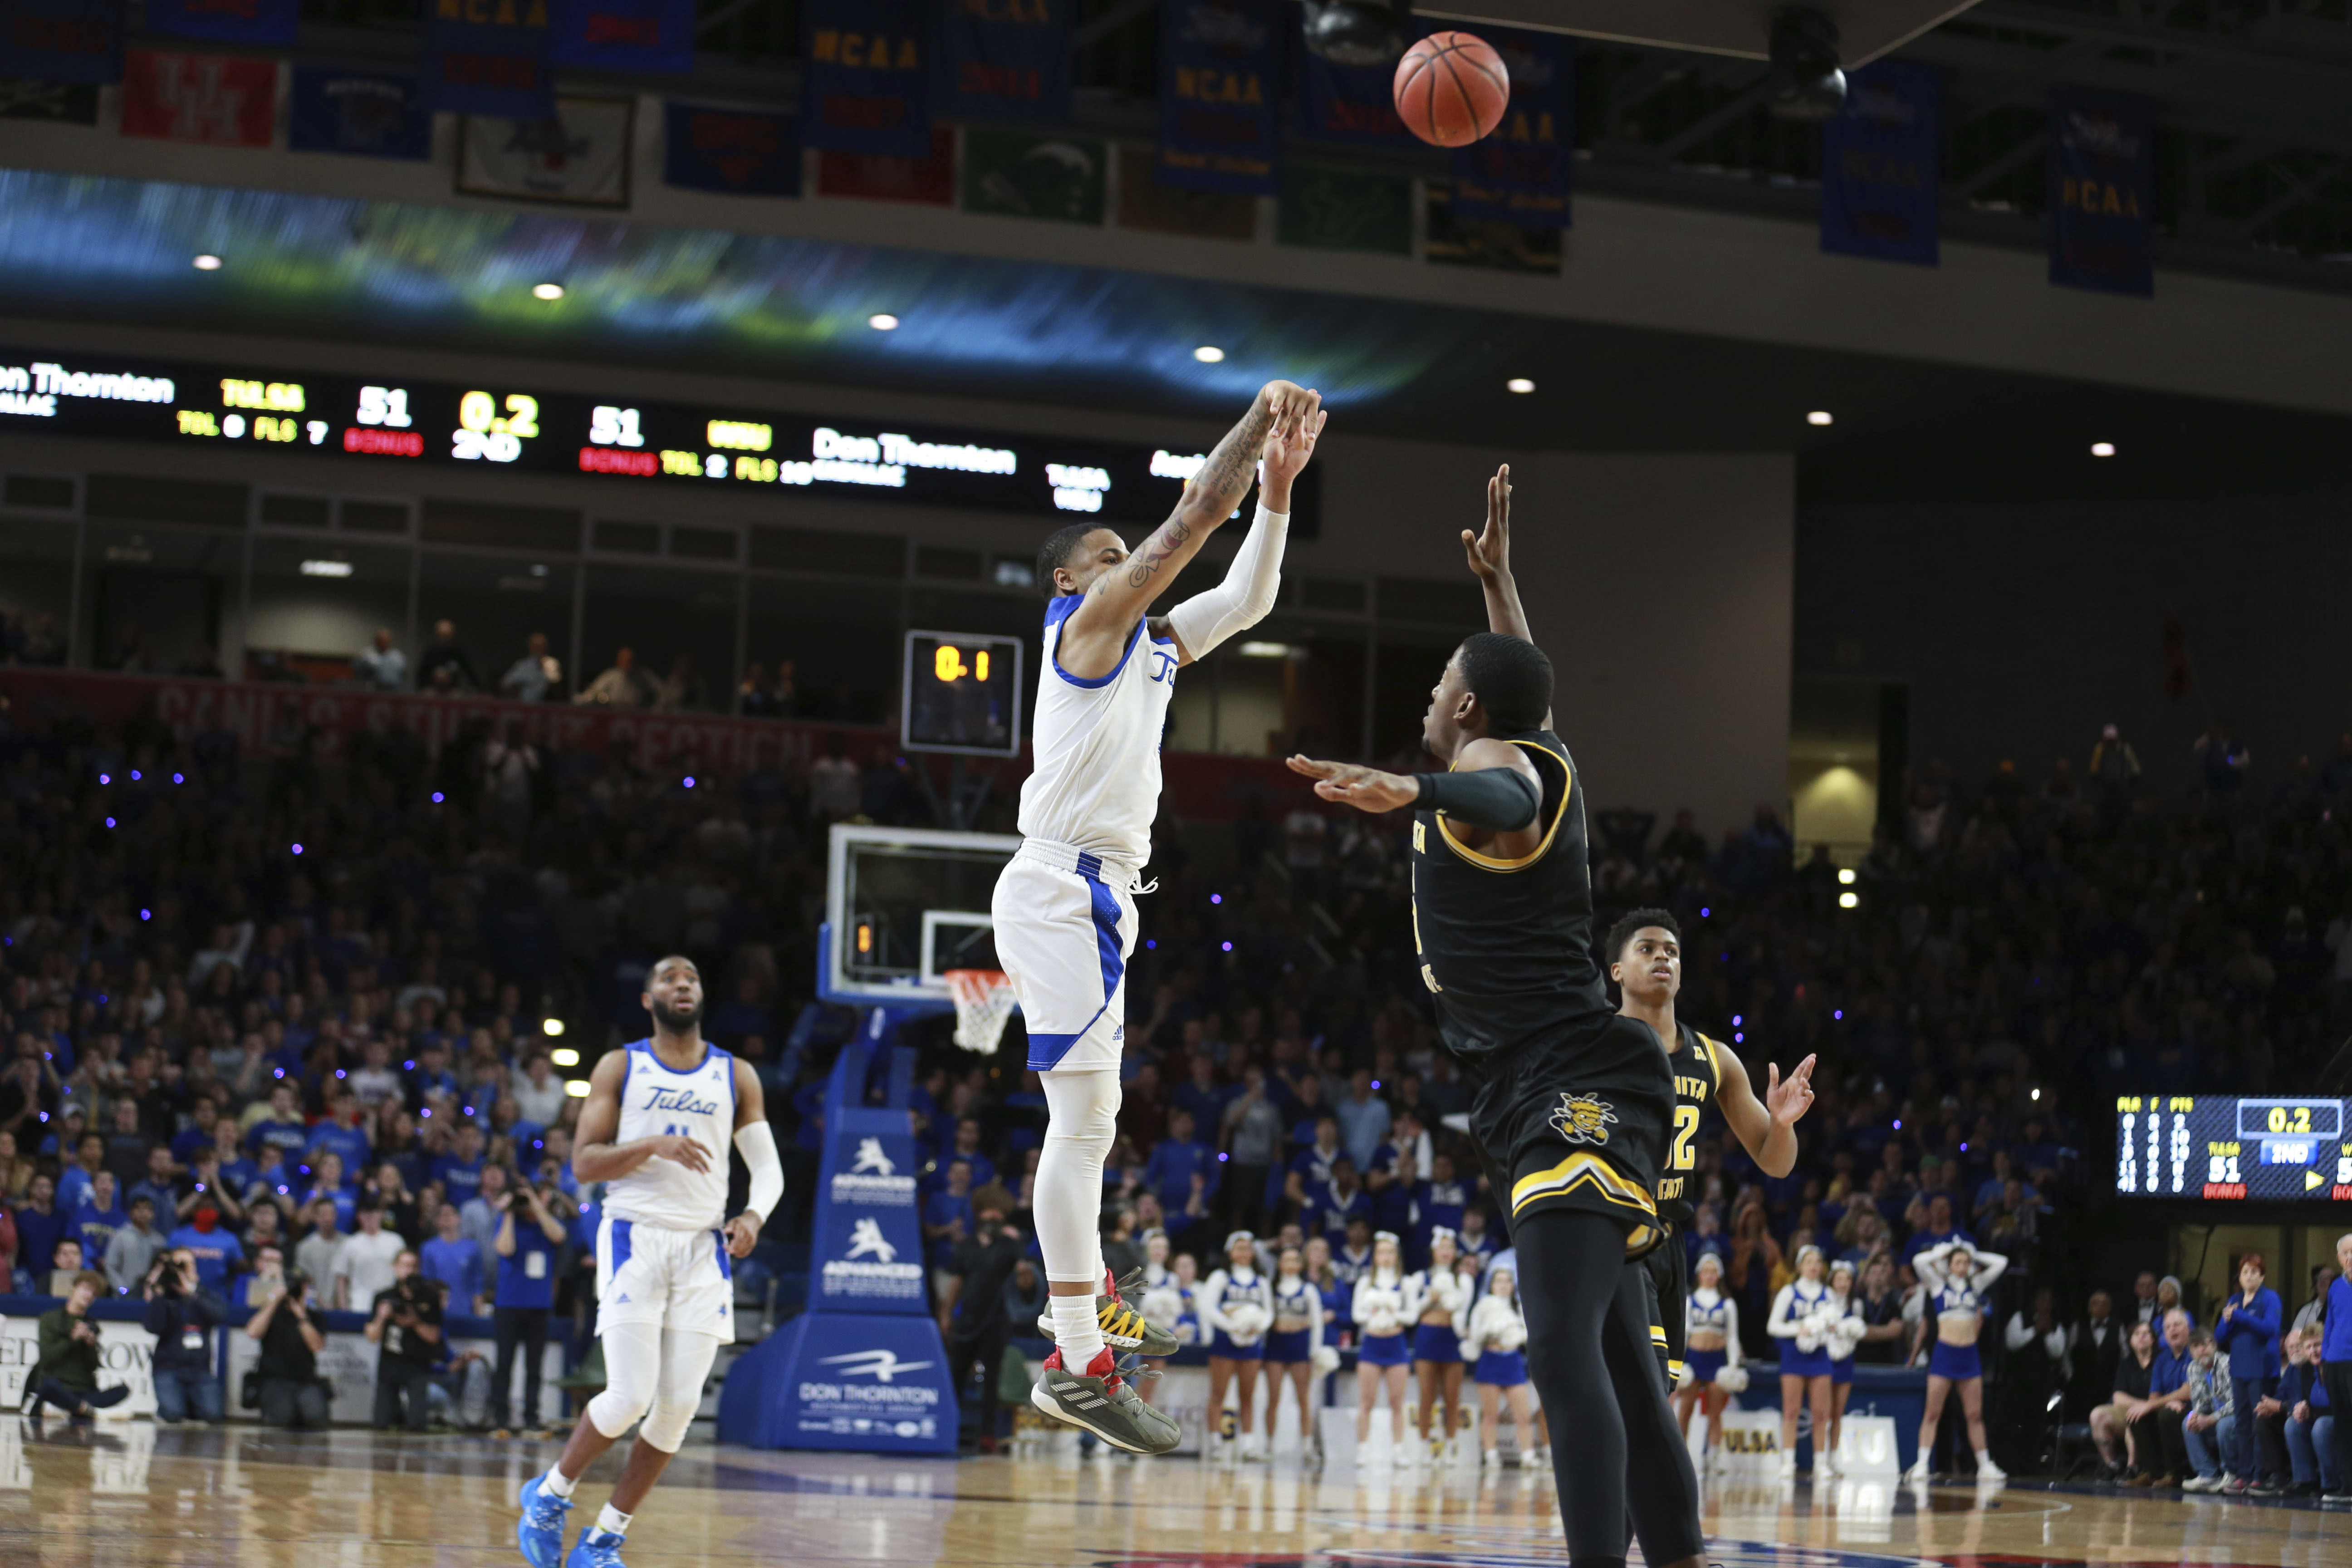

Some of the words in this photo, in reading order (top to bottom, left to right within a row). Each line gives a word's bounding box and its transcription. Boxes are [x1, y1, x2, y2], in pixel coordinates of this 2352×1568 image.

[812, 29, 919, 69] NCAA
[1175, 66, 1263, 104] NCAA
[2061, 177, 2141, 217] NCAA
[30, 363, 175, 404] Thornton
[357, 386, 412, 427] 51
[459, 391, 539, 438] 0.2
[589, 406, 645, 447] 51
[813, 428, 879, 463] Don
[877, 433, 1016, 475] Thornton
[935, 645, 990, 682] 0.1
[642, 1086, 719, 1139] Tulsa
[2268, 1107, 2312, 1133] 0.2
[1663, 1105, 1700, 1170] 2
[2208, 1141, 2241, 1157] TULSA
[2271, 1143, 2309, 1164] 2ND
[2208, 1156, 2242, 1183] 51
[799, 1382, 843, 1402] DON
[843, 1383, 939, 1406] THORNTON
